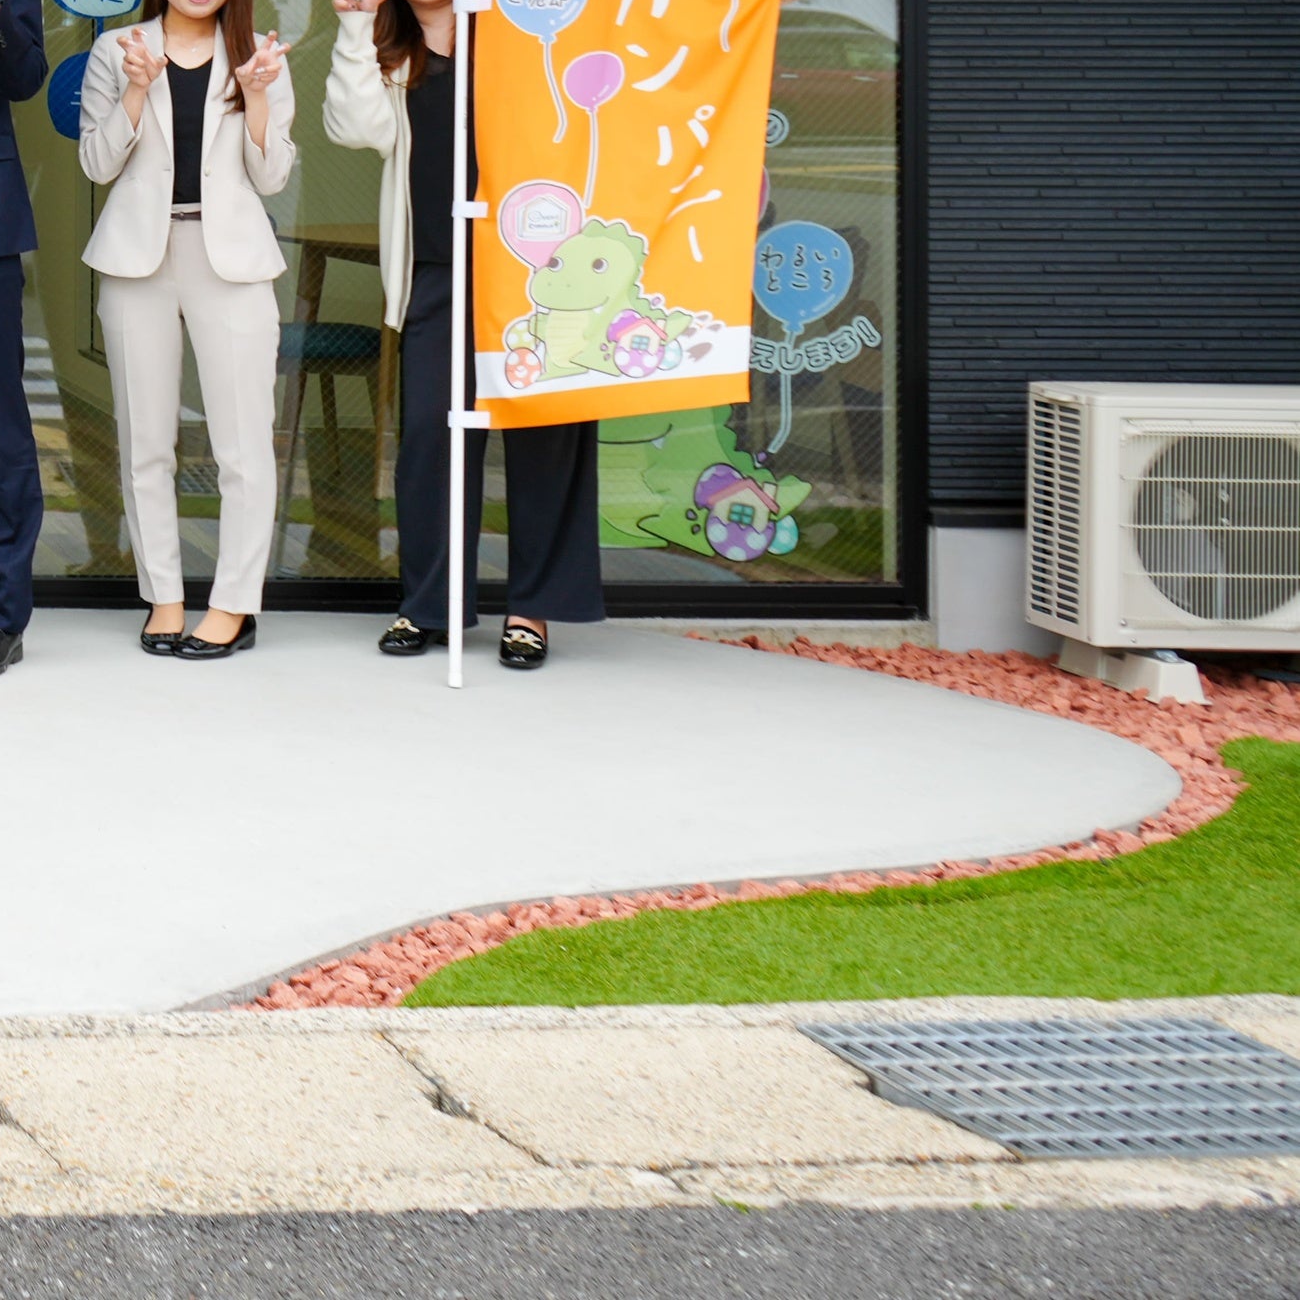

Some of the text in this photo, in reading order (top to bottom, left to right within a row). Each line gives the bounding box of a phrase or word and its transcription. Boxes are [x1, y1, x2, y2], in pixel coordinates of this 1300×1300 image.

[760, 243, 840, 269] わるい
[766, 269, 833, 294] ところ
